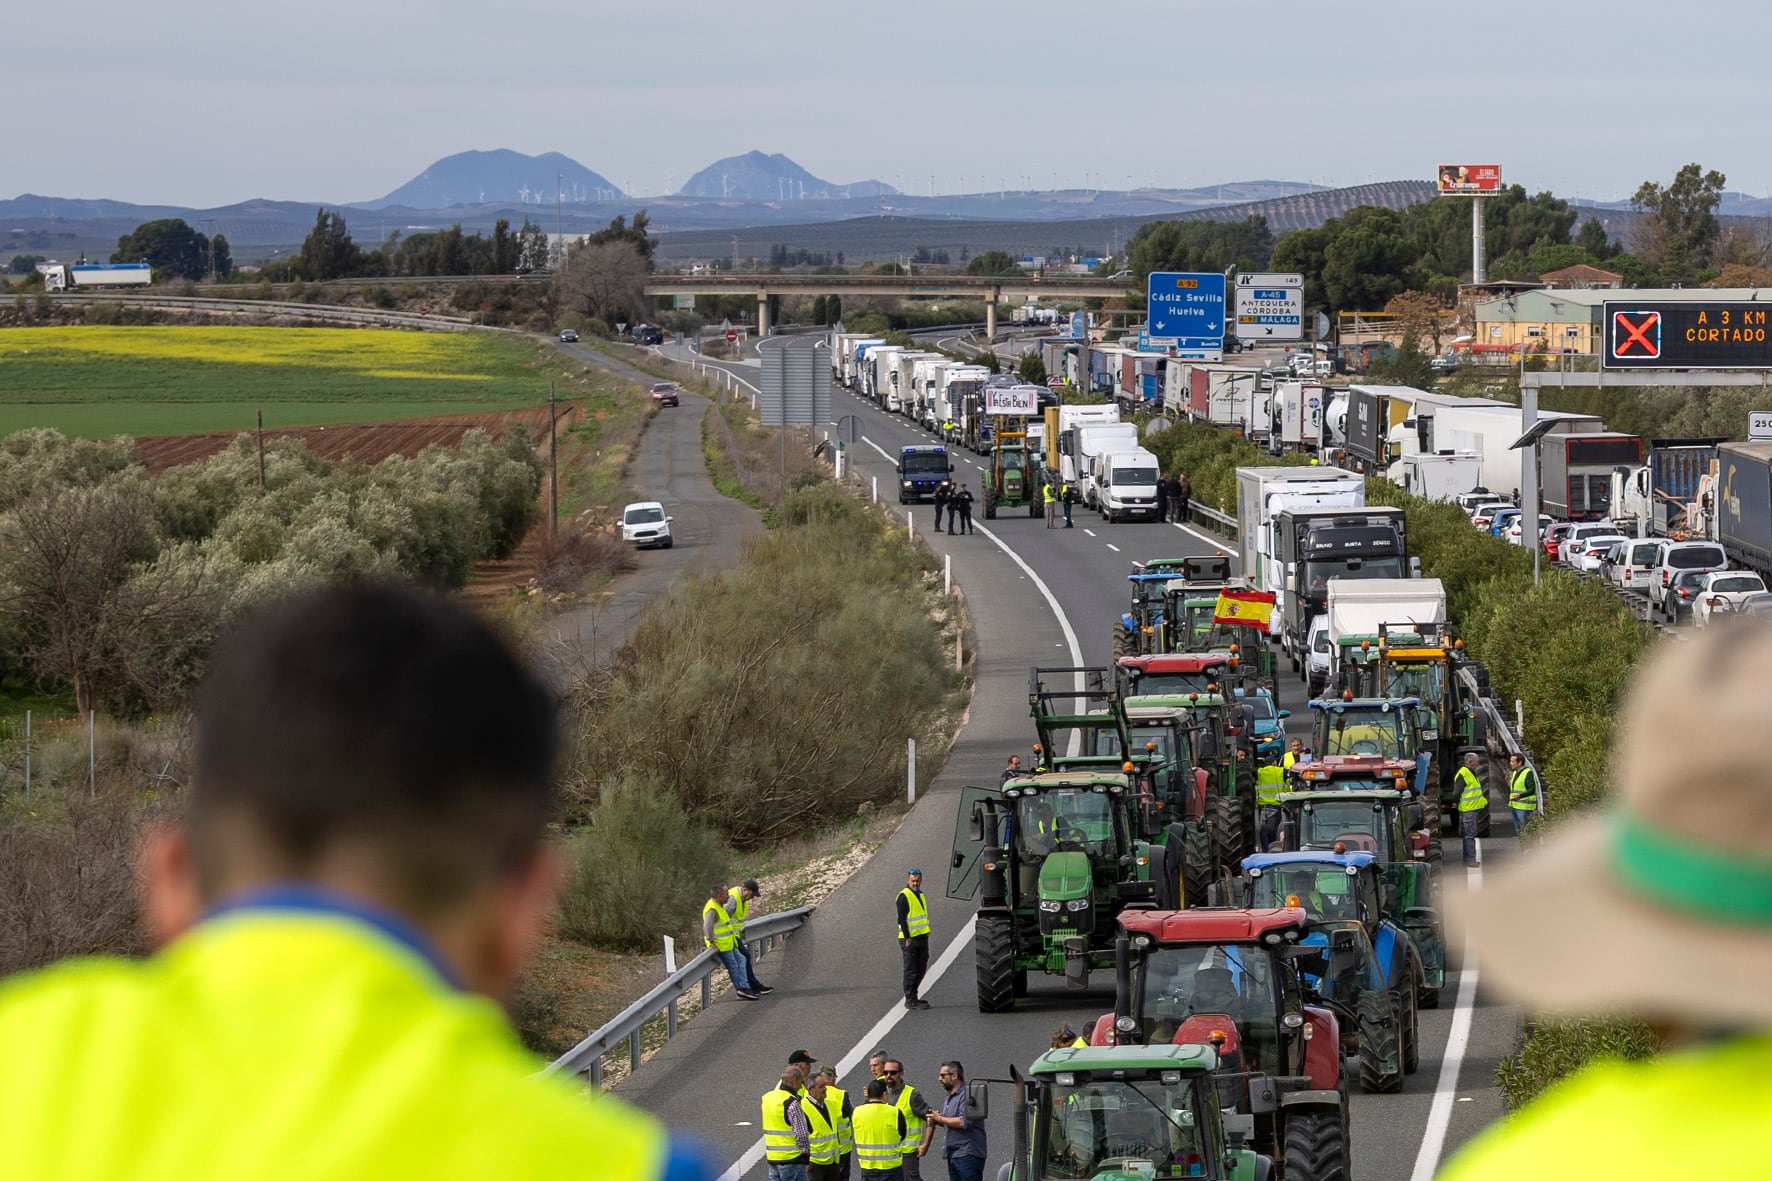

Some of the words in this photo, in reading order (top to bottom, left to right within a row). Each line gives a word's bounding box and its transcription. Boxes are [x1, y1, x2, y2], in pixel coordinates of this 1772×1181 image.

[1152, 293, 1181, 302] Cádiz
[1186, 293, 1222, 303] Sevilla
[1168, 306, 1205, 316] Huelva
[1698, 311, 1708, 325] A
[1721, 311, 1730, 325] 3
[1744, 311, 1765, 325] KM
[1686, 328, 1765, 342] CORTADO
